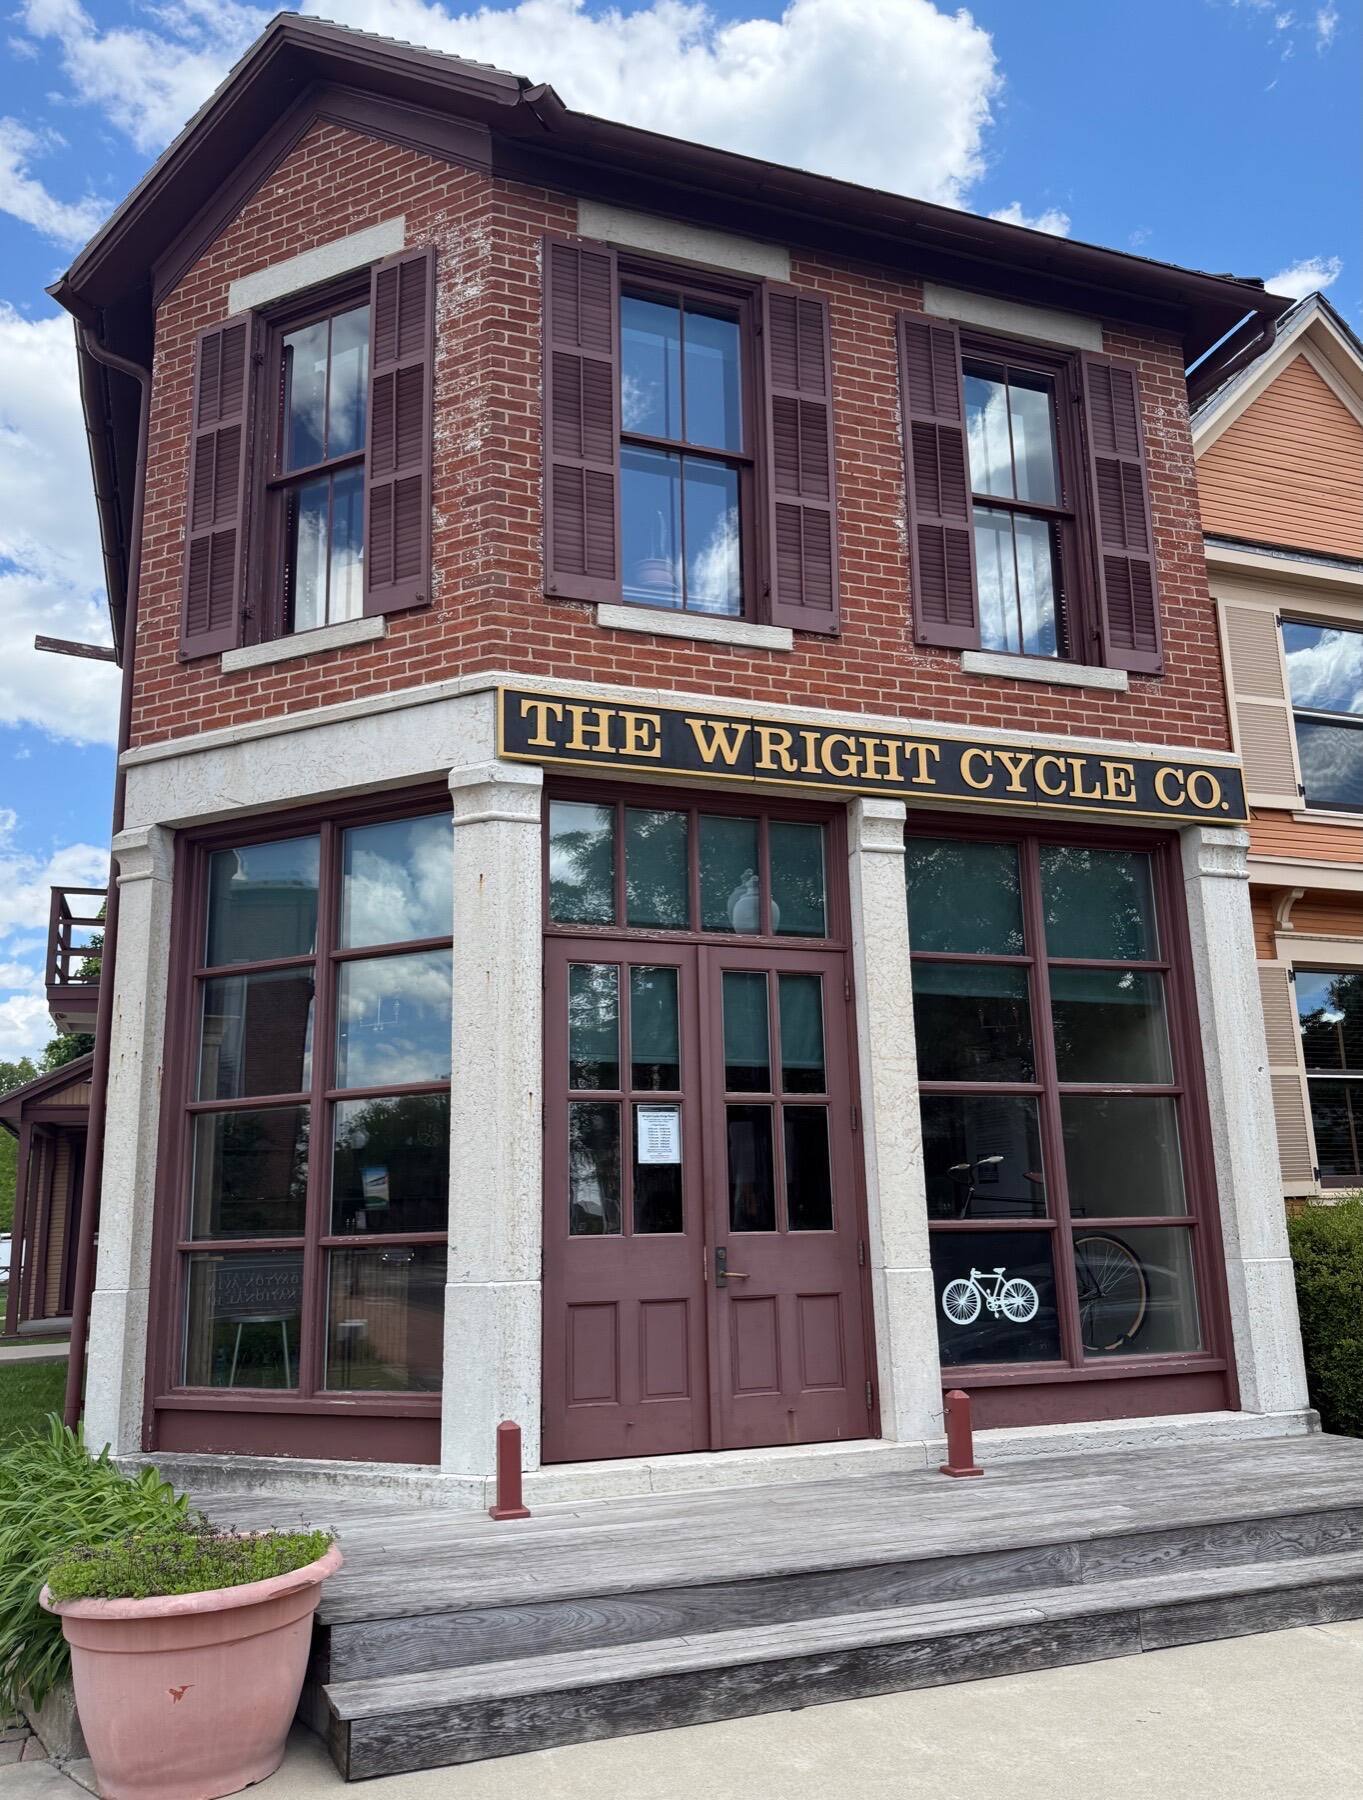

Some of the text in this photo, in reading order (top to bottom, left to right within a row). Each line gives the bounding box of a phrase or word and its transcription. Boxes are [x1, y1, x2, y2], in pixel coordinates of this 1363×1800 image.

[520, 699, 1230, 811] THE WRIGHT CYCLE CO.
